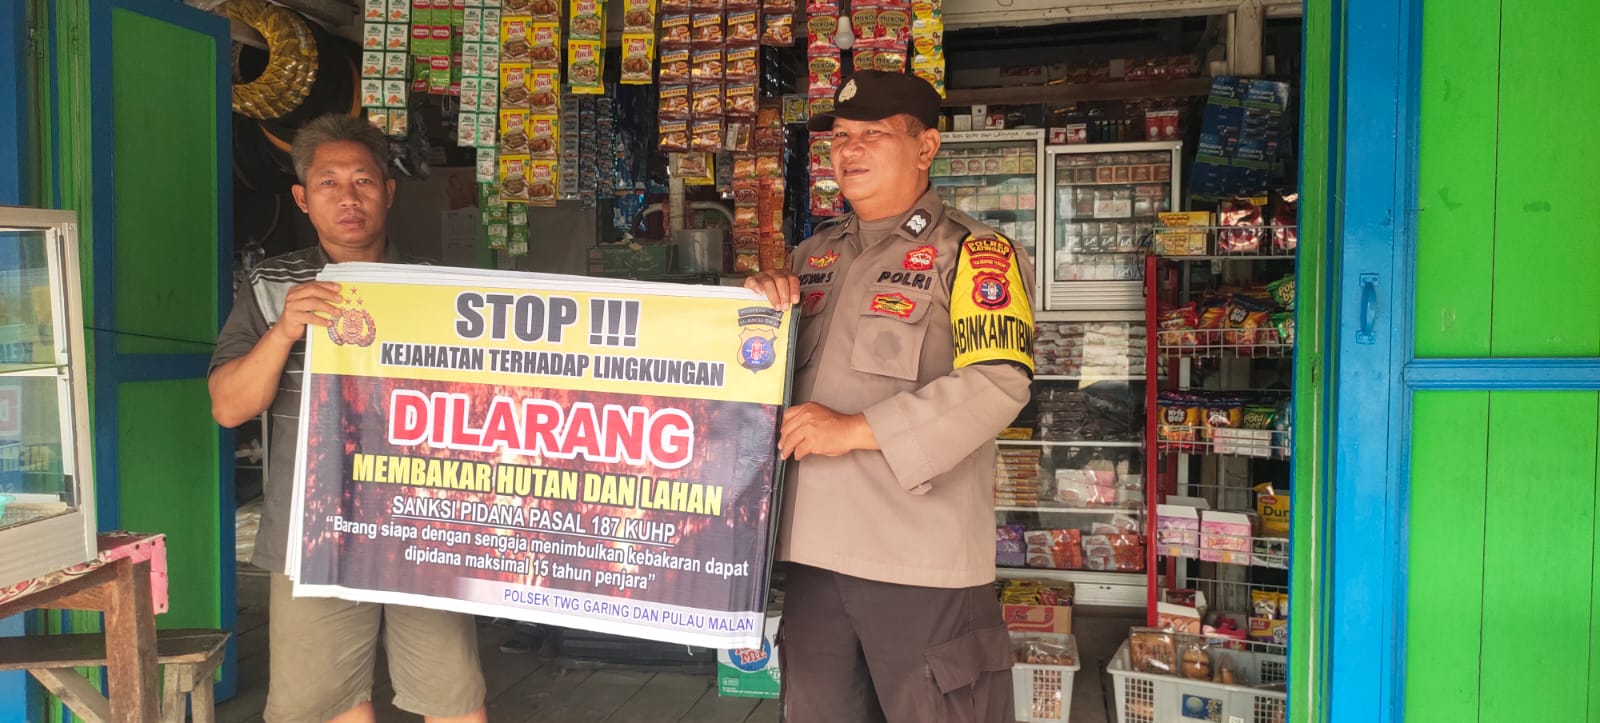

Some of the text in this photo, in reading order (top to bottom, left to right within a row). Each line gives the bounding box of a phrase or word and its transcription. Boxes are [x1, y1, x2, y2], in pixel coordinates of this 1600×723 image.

[880, 15, 906, 23] MILKOW
[876, 271, 932, 291] POLRI
[456, 292, 640, 347] STOP !!!
[952, 313, 1034, 359] ABINKAMTIBM
[381, 343, 725, 387] KEJAHATAN TERHADAP LINGKUNGAN
[391, 392, 691, 467] DILARANG
[352, 453, 723, 516] MEMBAKAR HUTAN DAN LAHAN
[392, 495, 676, 543] SANKSI PIDANA PASAL 187 KUHP
[381, 521, 418, 541] siapa
[421, 525, 471, 547] dengan
[475, 530, 527, 554] sengaja
[530, 538, 625, 563] menimbulkan
[626, 546, 701, 572] kebakaran
[705, 557, 750, 580] dapat
[404, 545, 462, 565] dipidana
[465, 554, 529, 575] maksimal
[533, 559, 549, 577] 15
[552, 561, 592, 583] tahun
[504, 588, 754, 632] POLSEK TWG GARING DAN PULAU MALAN
